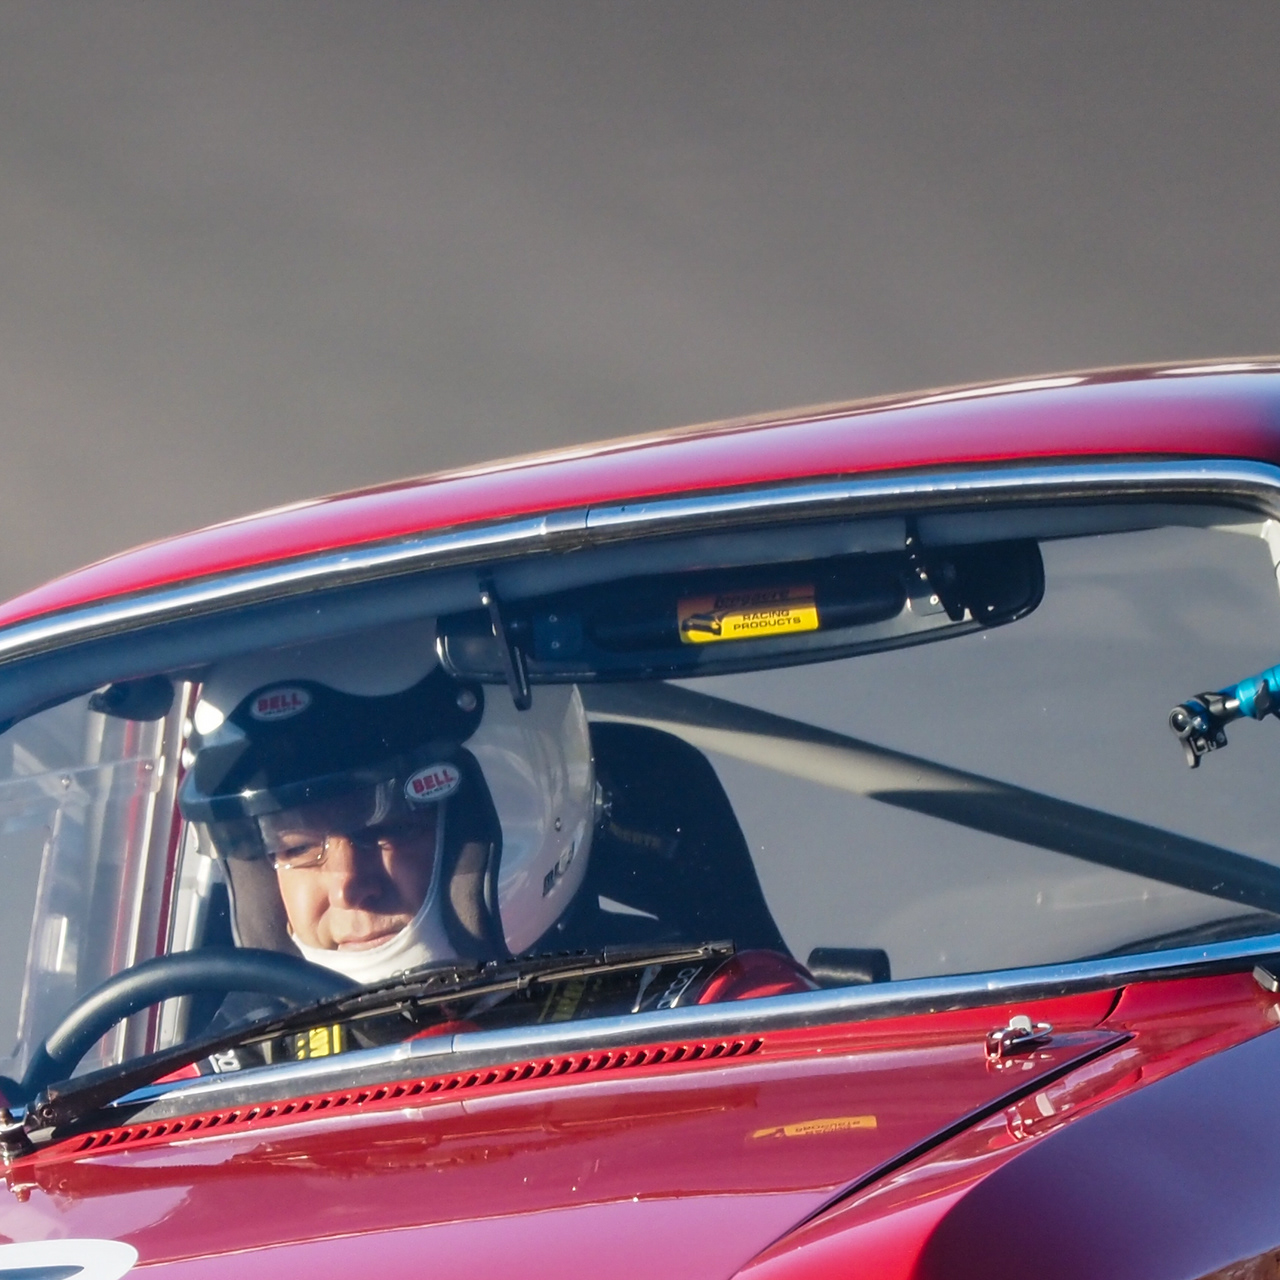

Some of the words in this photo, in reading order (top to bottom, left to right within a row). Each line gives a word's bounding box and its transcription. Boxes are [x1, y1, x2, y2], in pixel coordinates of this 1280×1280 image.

[733, 616, 801, 631] PRODUCTS
[742, 610, 790, 621] RACING
[257, 692, 302, 713] BELL
[411, 768, 455, 794] BELL
